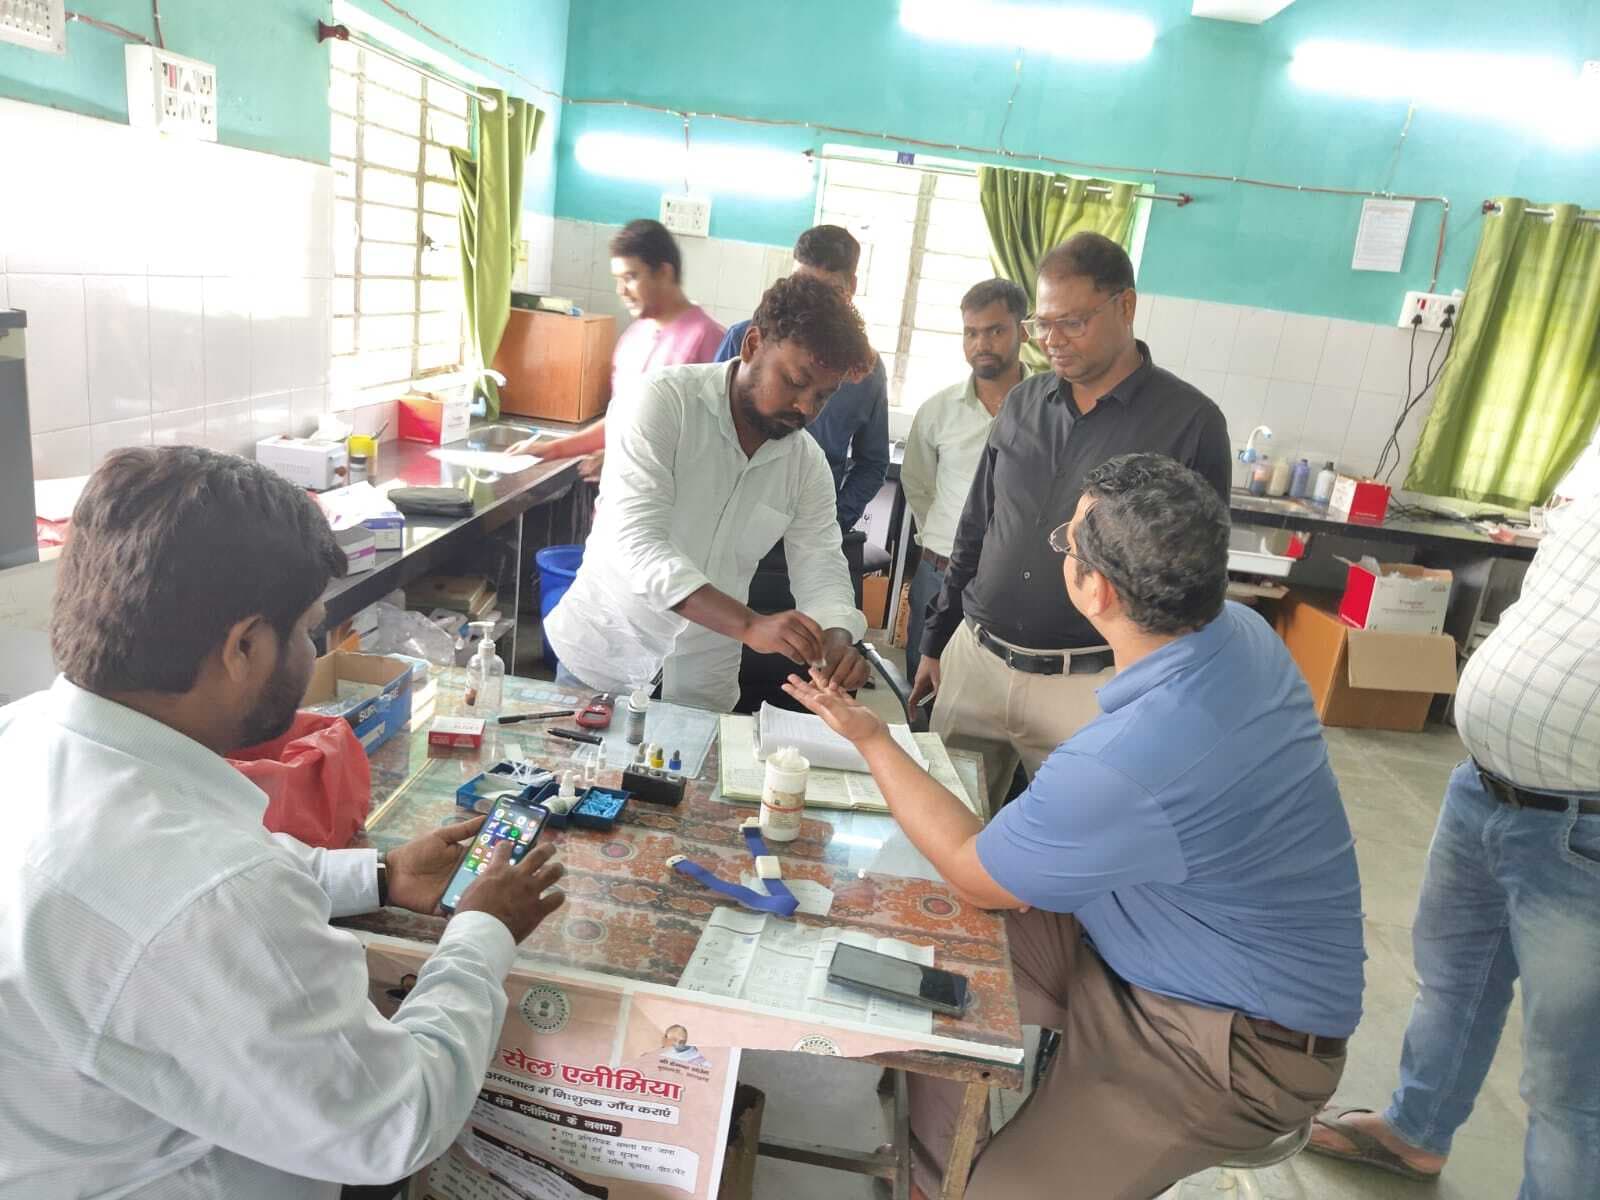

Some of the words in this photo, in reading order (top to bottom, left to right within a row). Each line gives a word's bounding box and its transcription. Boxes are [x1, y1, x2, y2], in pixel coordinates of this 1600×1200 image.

[485, 1071, 535, 1093] अस्पताल
[552, 1088, 603, 1107] निःशुल्क
[502, 1048, 555, 1077] सेल
[562, 1064, 682, 1100] एनीमिया
